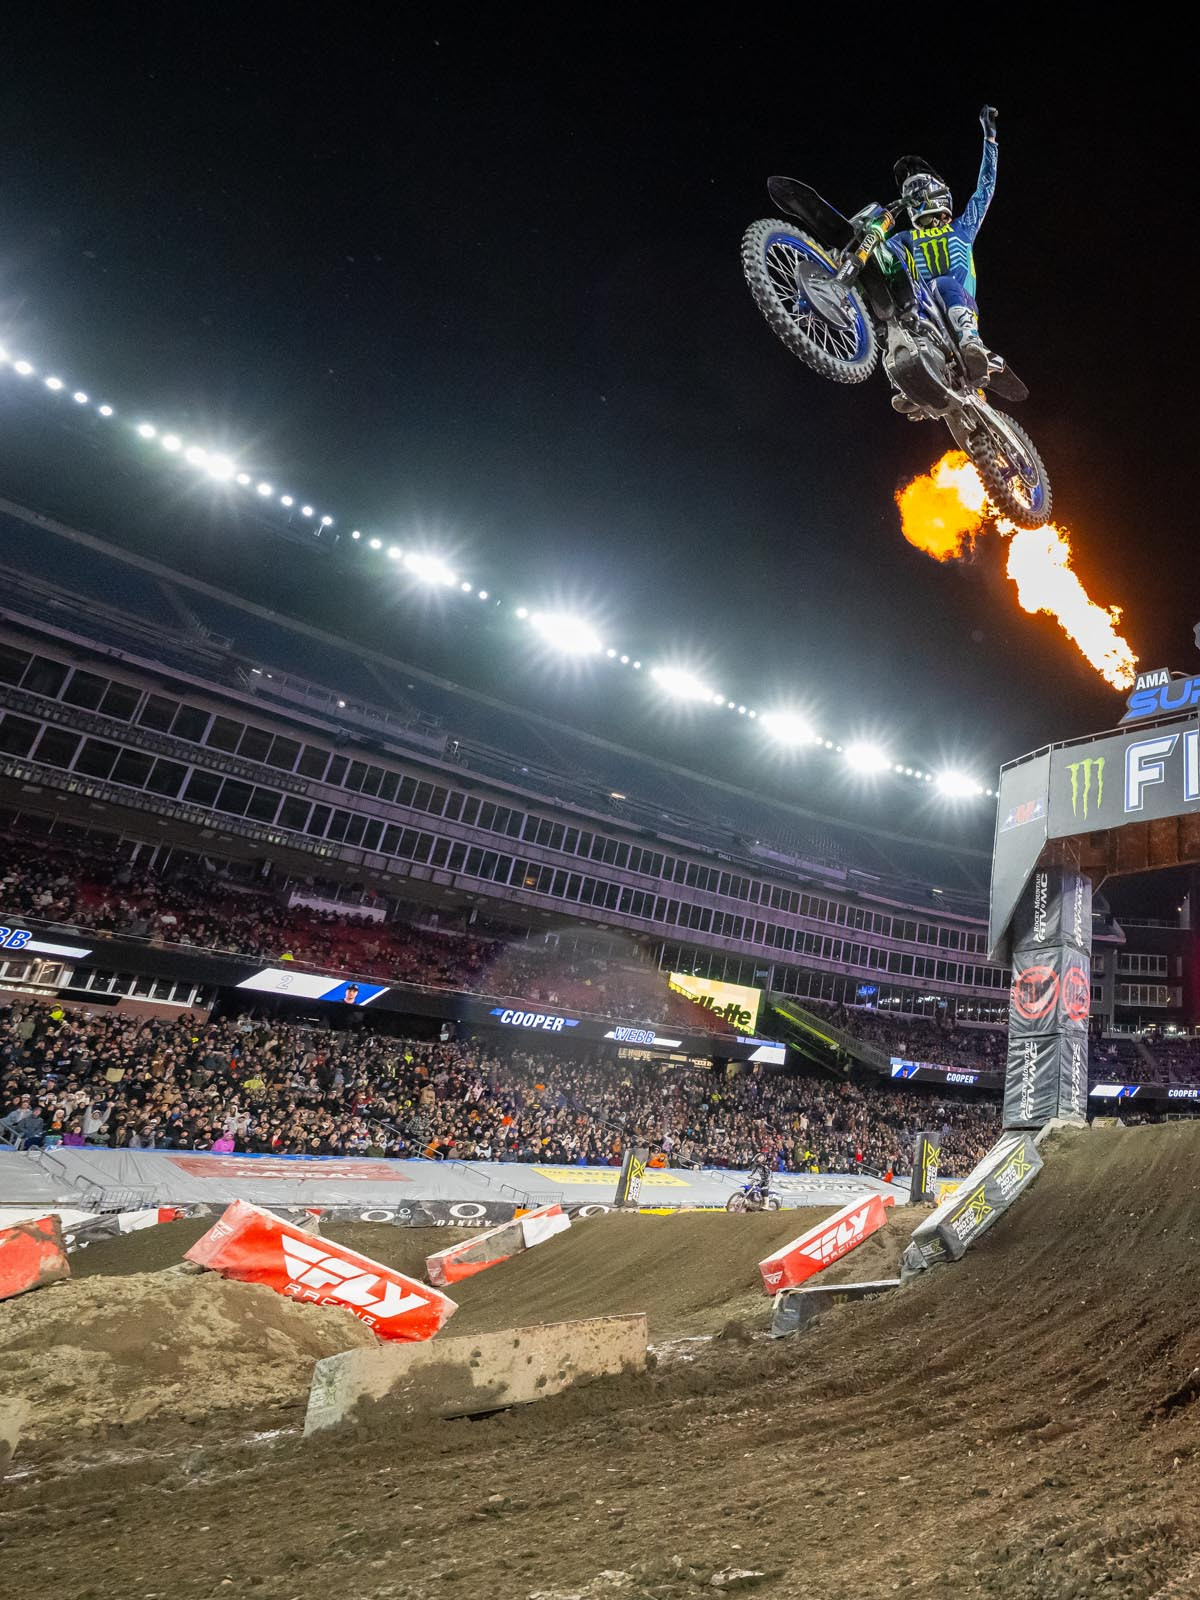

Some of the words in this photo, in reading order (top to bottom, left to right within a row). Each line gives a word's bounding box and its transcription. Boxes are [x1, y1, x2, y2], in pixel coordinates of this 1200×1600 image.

[1136, 667, 1169, 690] AMA
[276, 975, 294, 991] 2
[500, 1010, 565, 1031] COOPER
[613, 1026, 656, 1044] WEBB
[946, 1072, 974, 1084] COOPER
[1168, 1089, 1198, 1098] COOPER
[434, 1219, 493, 1227] OAKLEY
[952, 1206, 975, 1230] SUPER
[956, 1213, 975, 1233] MOTO
[800, 1205, 871, 1261] FLY
[958, 1219, 978, 1240] CROSS
[822, 1233, 864, 1265] RACING
[281, 1234, 430, 1318] FLY
